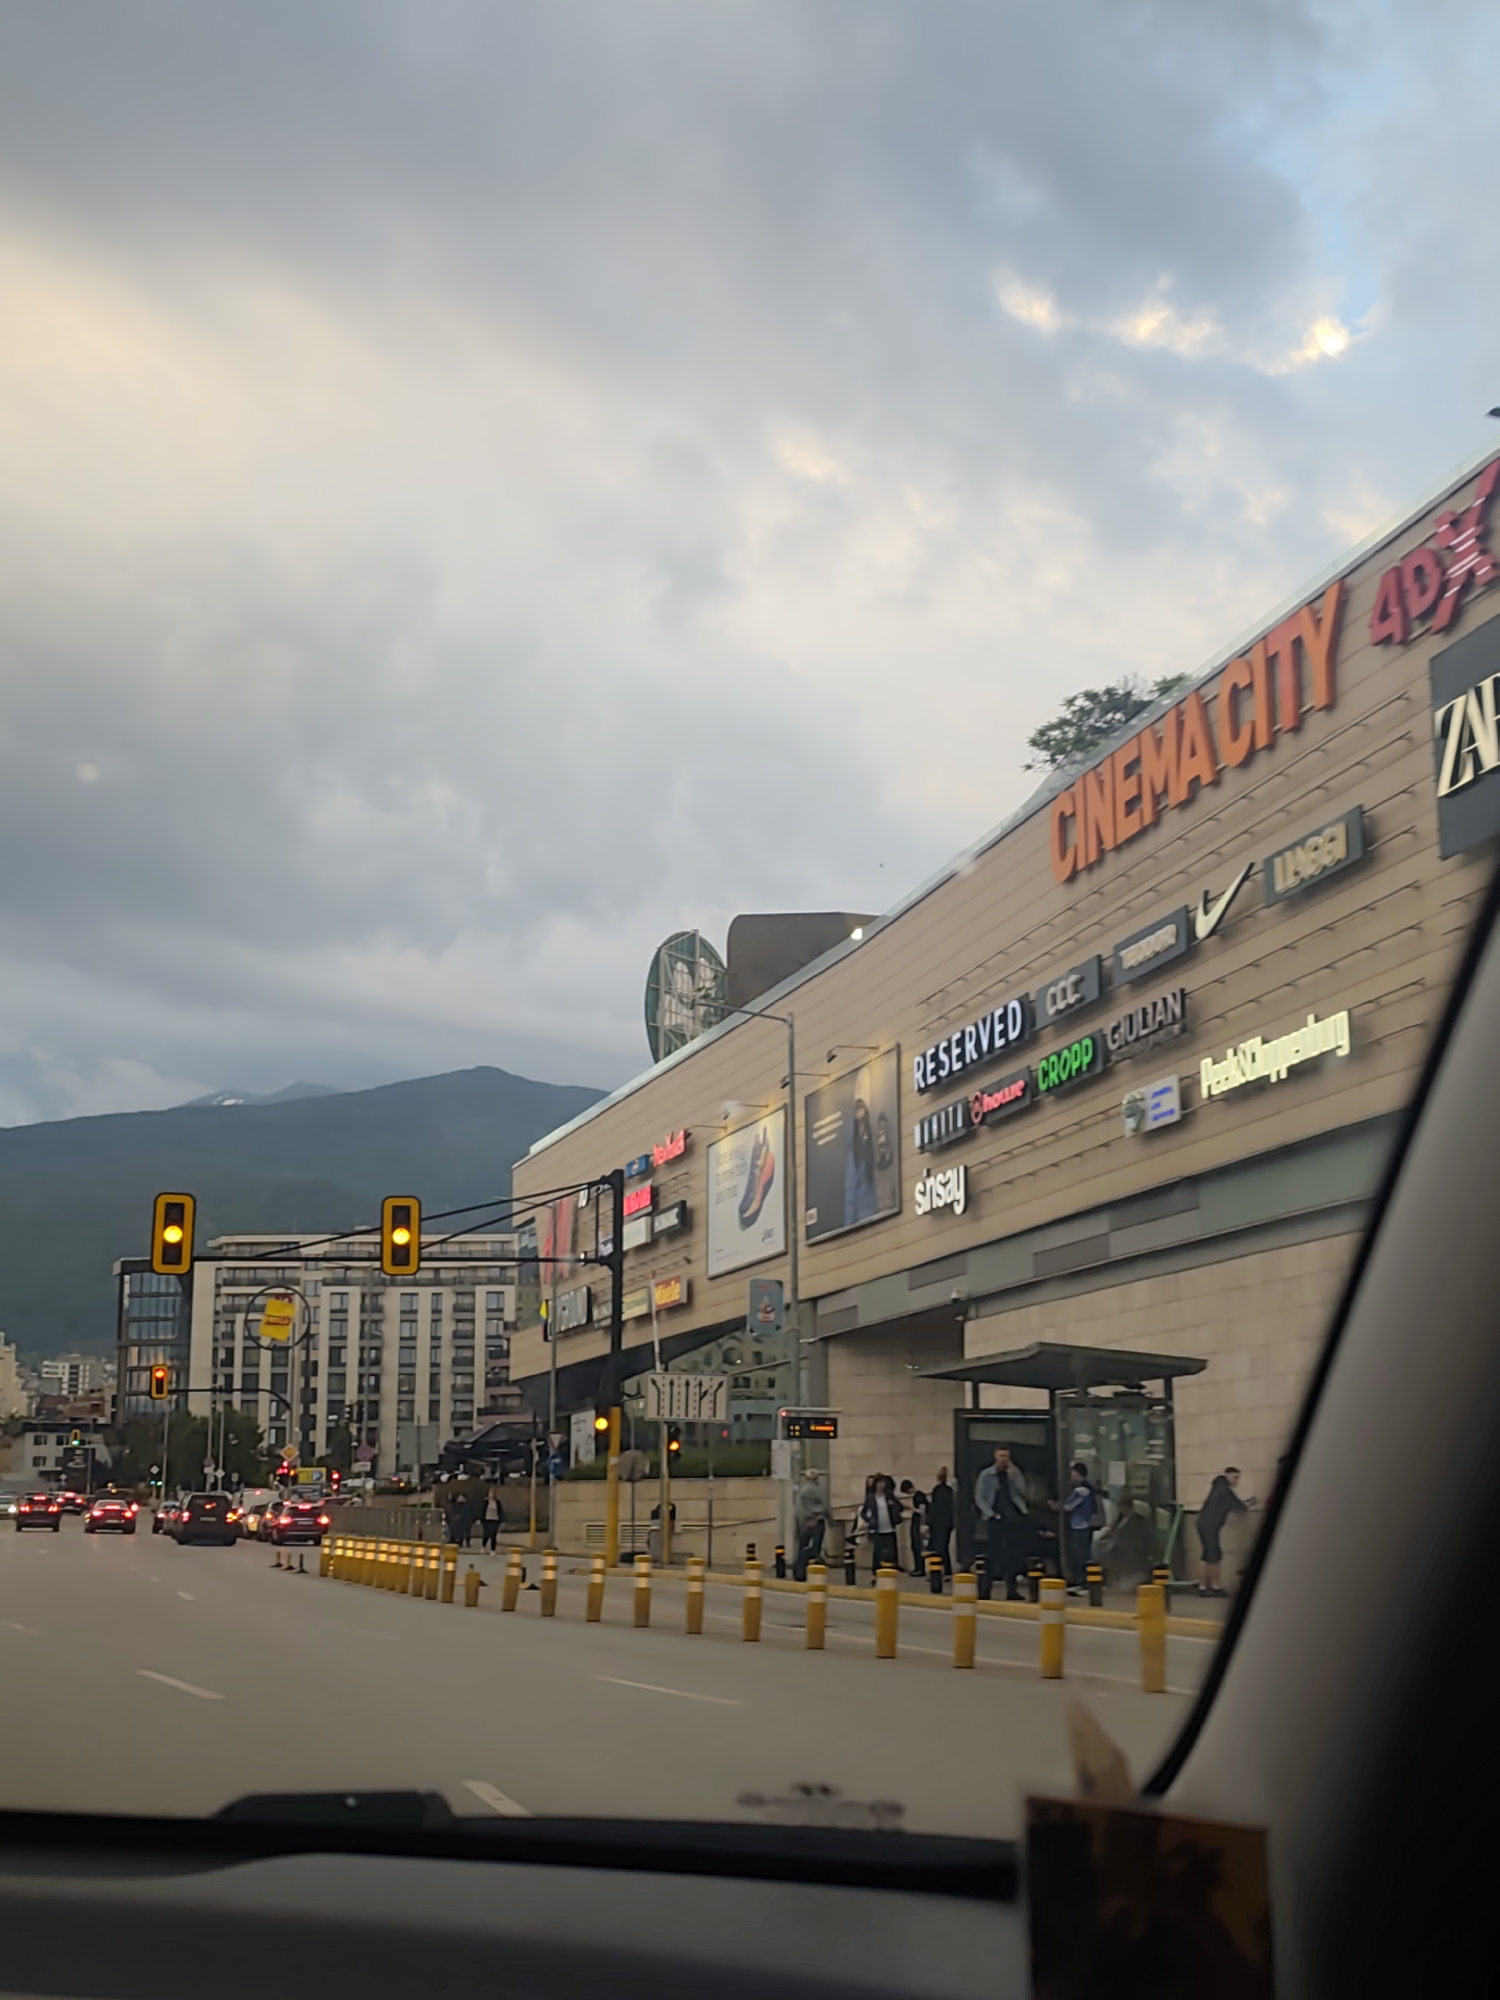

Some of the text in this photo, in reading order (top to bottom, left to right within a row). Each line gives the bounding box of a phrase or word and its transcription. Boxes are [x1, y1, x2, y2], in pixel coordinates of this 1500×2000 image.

[1369, 456, 1500, 645] 4DX
[1050, 579, 1344, 885] CINEMA CITY
[913, 999, 1022, 1092] RESERVED
[1107, 988, 1185, 1051] GIULIAN
[1038, 1036, 1094, 1092] CROPP
[914, 1165, 966, 1216] sinsay
